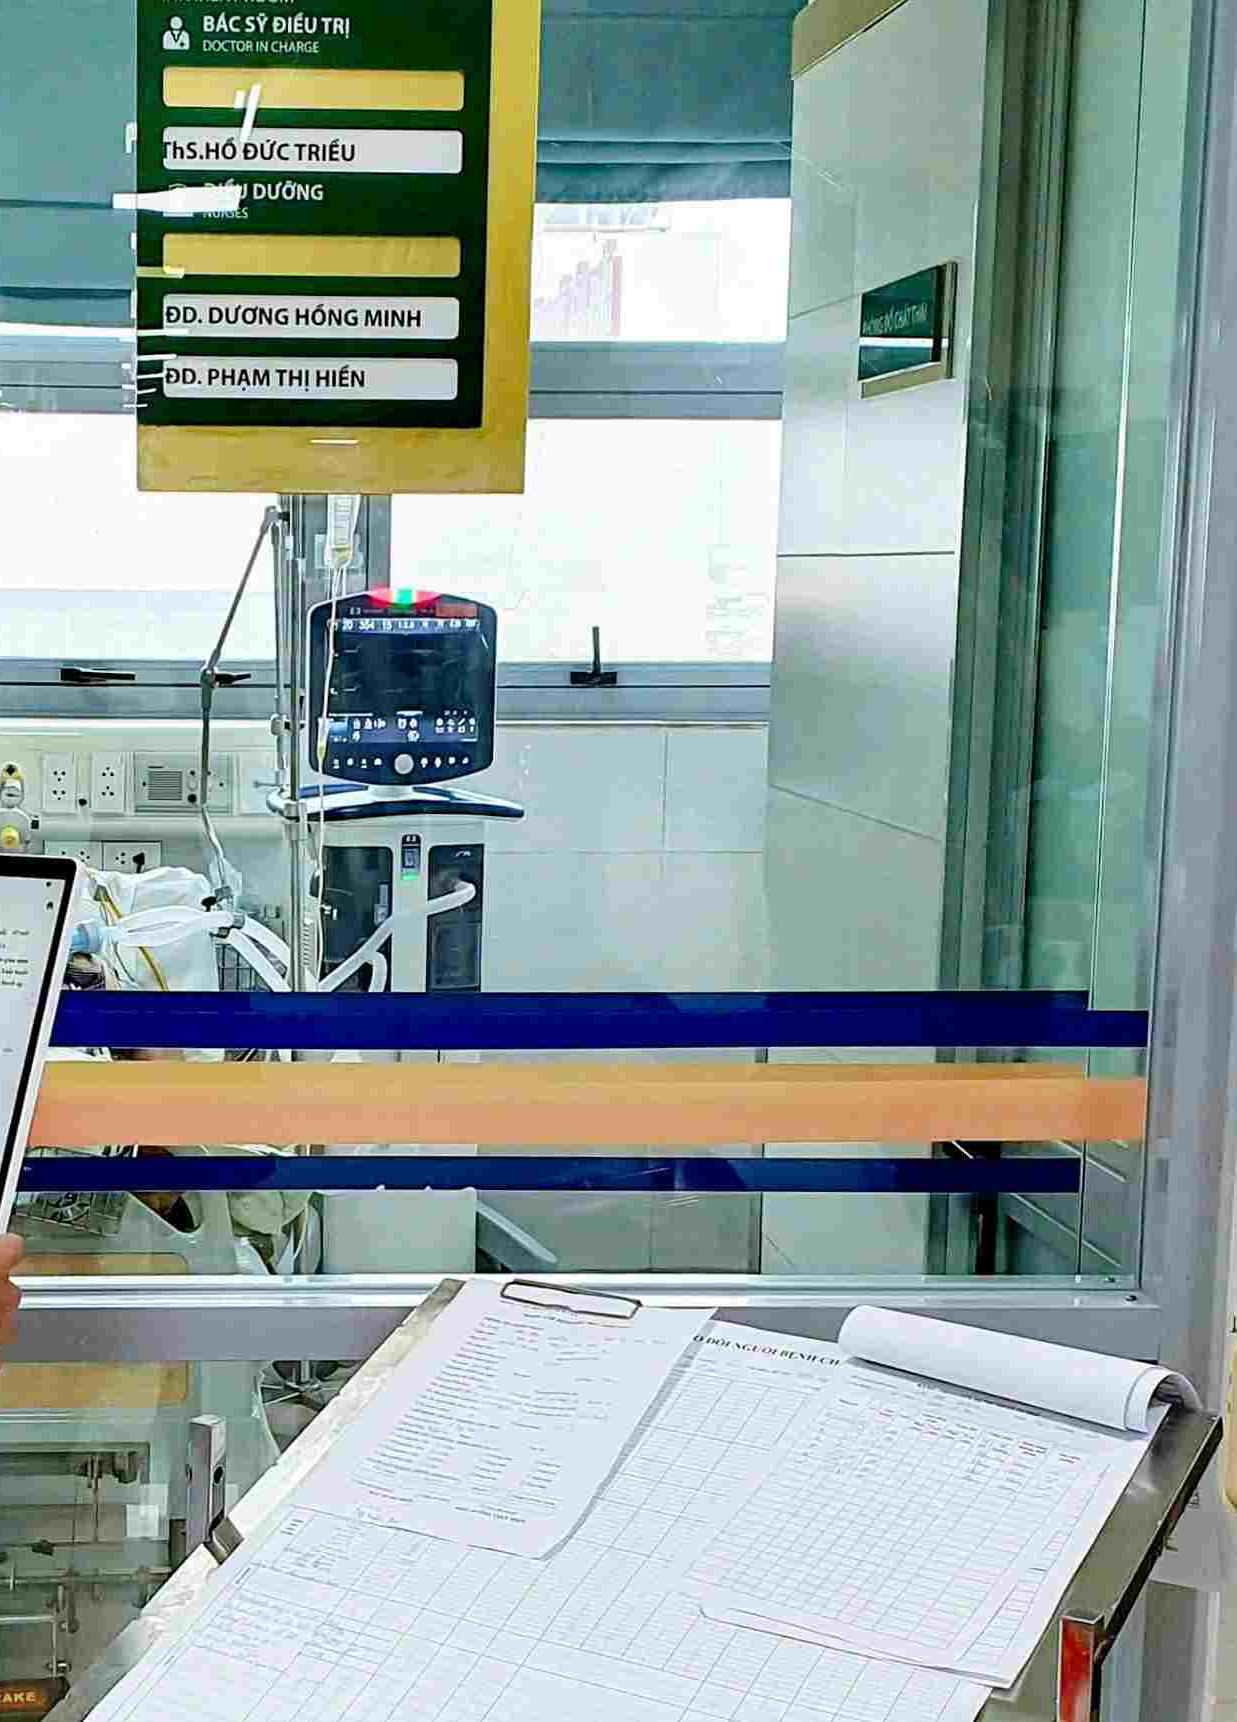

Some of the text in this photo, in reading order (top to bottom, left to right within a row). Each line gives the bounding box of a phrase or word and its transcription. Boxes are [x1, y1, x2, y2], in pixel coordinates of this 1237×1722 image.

[202, 12, 241, 33] BÁC
[244, 12, 269, 33] SỸ
[321, 17, 351, 39] TRỊ
[202, 40, 320, 54] DOCTOR IN CHARGE
[165, 306, 202, 324] ĐD.
[208, 305, 289, 325] DƯƠNG
[364, 309, 422, 328] MINH
[165, 368, 202, 385] ĐD.
[207, 368, 271, 391] PHẠM
[275, 369, 310, 392] THỊ
